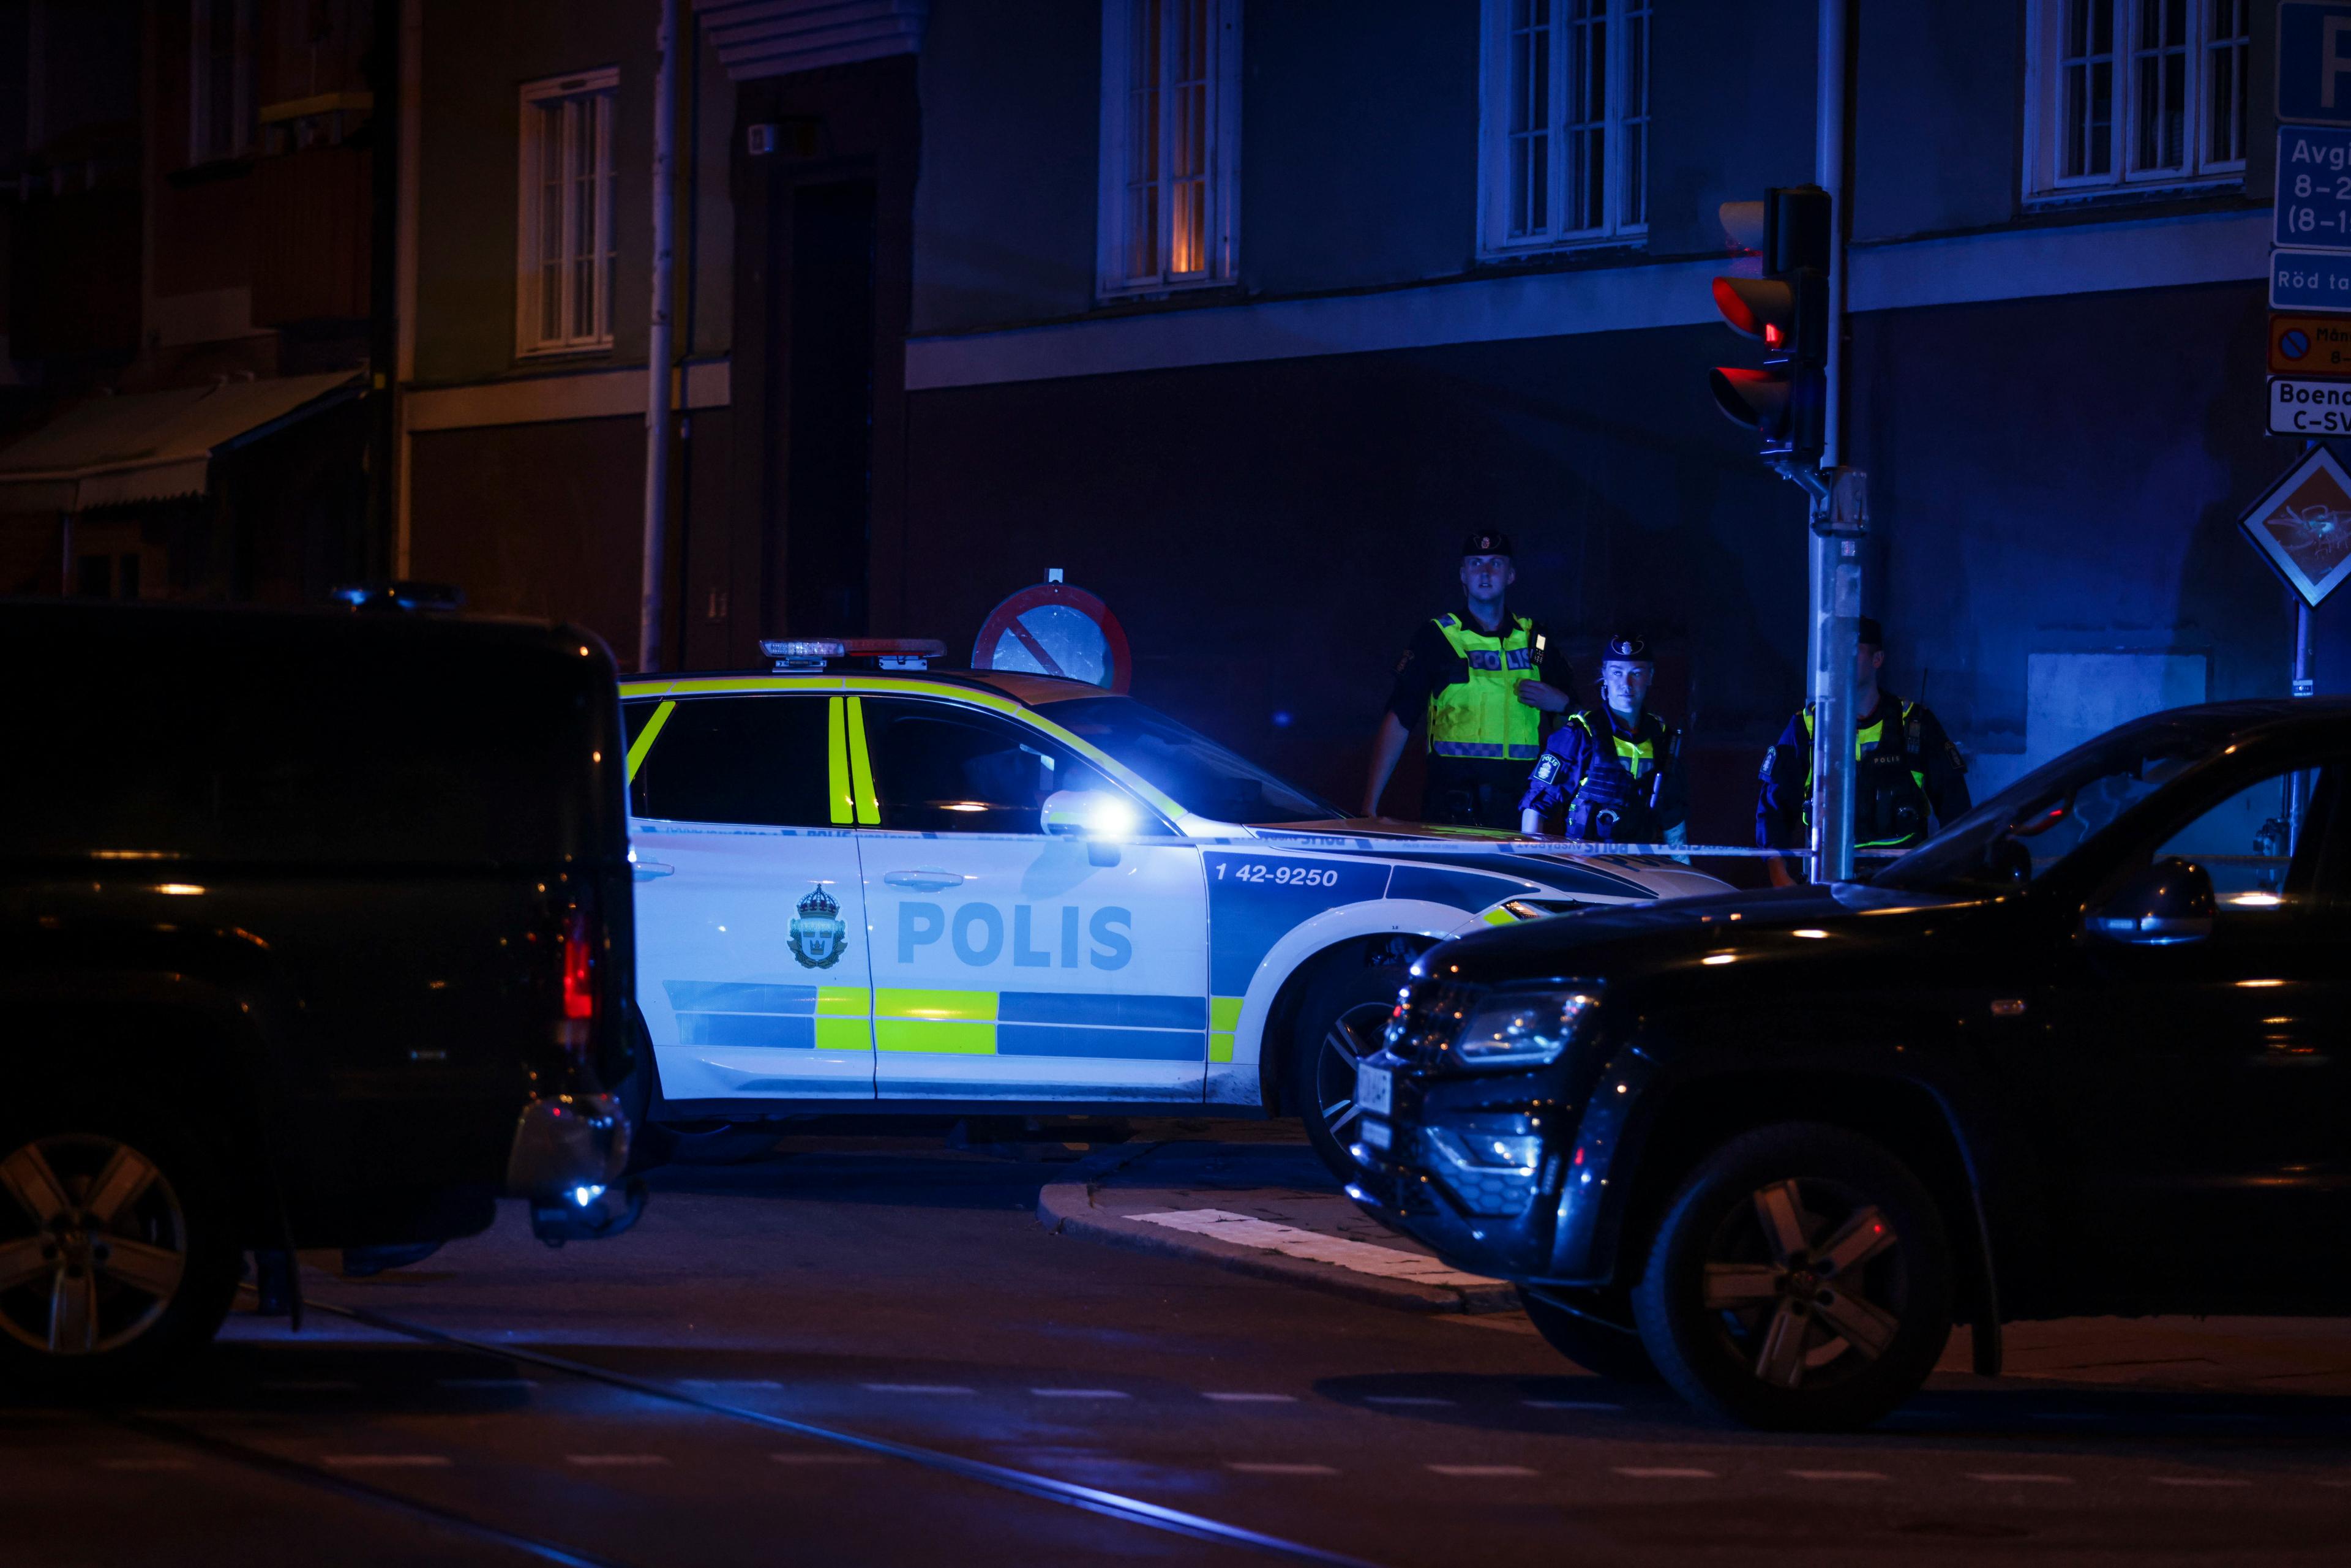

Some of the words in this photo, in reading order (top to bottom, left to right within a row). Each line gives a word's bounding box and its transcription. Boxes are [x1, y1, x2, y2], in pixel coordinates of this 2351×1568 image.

[2278, 271, 2319, 289] Röd
[1469, 649, 1534, 670] POLIS
[1874, 755, 1900, 765] POLIS
[1216, 863, 1227, 880] 1
[1235, 864, 1338, 887] 42-9250
[898, 901, 1133, 971] POLIS
